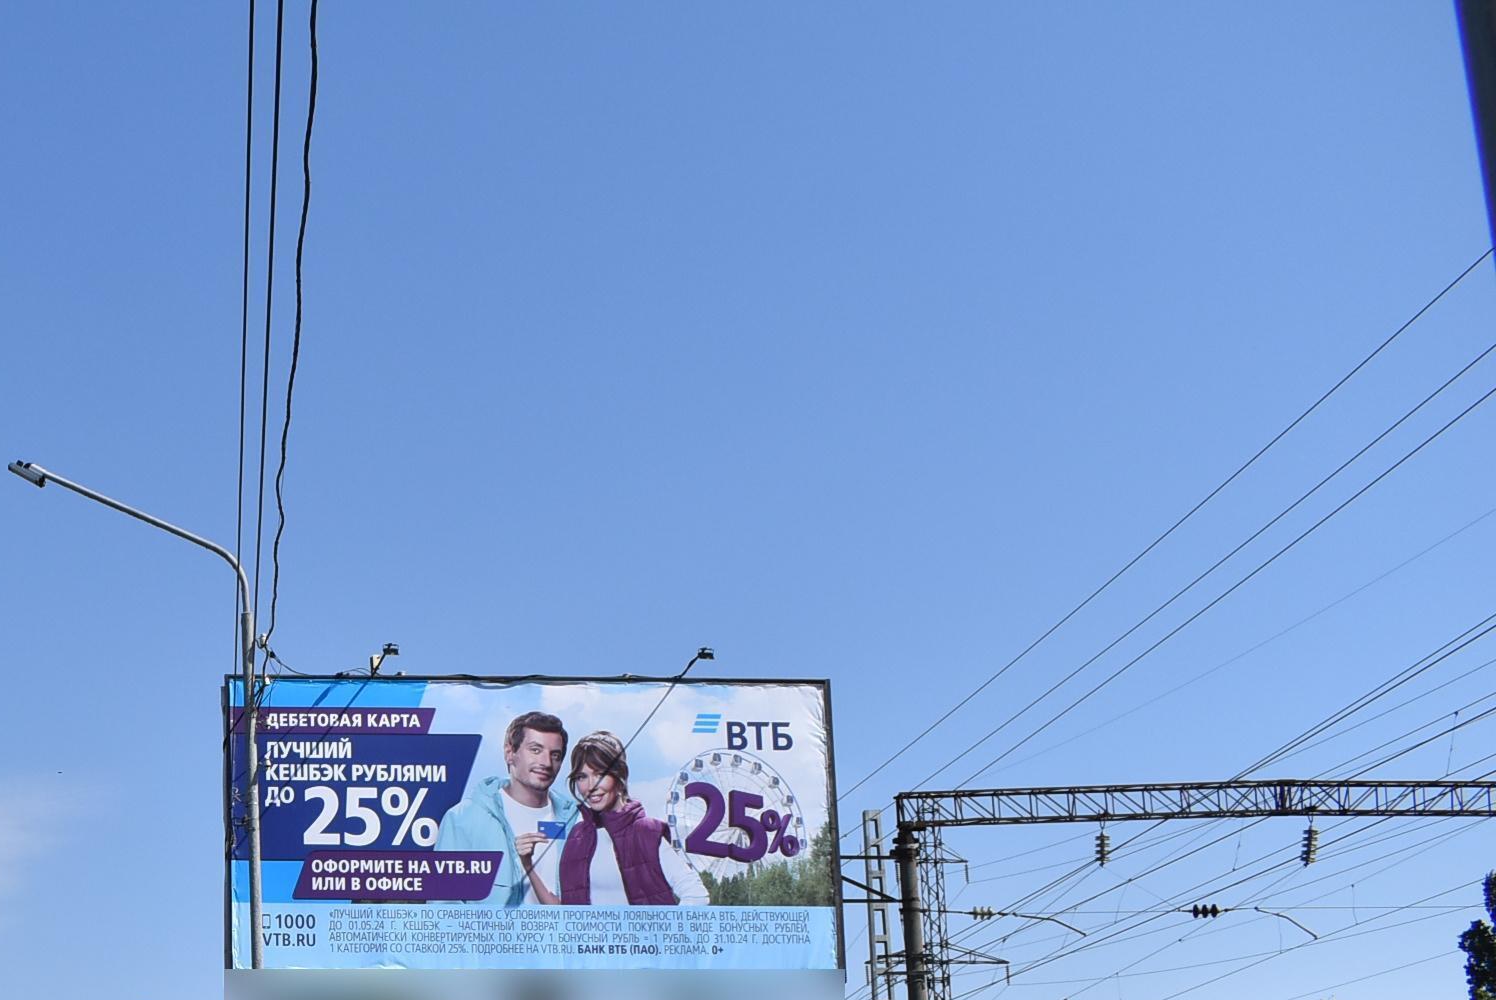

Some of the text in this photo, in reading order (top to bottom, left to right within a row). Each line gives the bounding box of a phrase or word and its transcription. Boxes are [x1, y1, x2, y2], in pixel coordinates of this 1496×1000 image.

[266, 712, 421, 730] ДЕБЕТОВАЯ КАРТА
[726, 721, 793, 750] ВТБ
[264, 738, 352, 759] ЛУЧШИЙ
[265, 763, 447, 783] КЕШБЭК РУБЛЯМИ
[265, 785, 440, 847] ДО 25%
[684, 781, 800, 863] 25%
[311, 859, 492, 875] ОФОРМИТЕ НА VTB.RU
[311, 876, 423, 892] ИЛИ В ОФИСЕ
[275, 914, 316, 929] 1000
[420, 910, 434, 920] ПО
[436, 910, 494, 920] СРАВНЕНИЮ
[504, 910, 560, 920] УСЛОВИЯМИ
[562, 910, 620, 920] ПРОГРАММЫ
[622, 911, 683, 921] ЛОЯЛЬНОСТИ
[686, 911, 716, 921] БАНКА
[740, 910, 810, 923] ДЕЙСТВУЮЩЕЙ
[328, 921, 342, 931] ДО
[404, 921, 440, 931] КЕШБЭК
[458, 920, 515, 931] ЧАСТИЧНЫЙ
[520, 922, 559, 931] ВОЗВРАТ
[564, 922, 622, 931] СТОИМОСТИ
[628, 922, 672, 932] ПОКУПКИ
[690, 923, 714, 933] ВИДЕ
[719, 923, 768, 932] БОНУСНЫХ
[262, 933, 316, 947] VTB.RU
[328, 932, 407, 942] АВТОМАТИЧЕСКИ
[411, 933, 494, 942] КОНВЕРТИРУЕМЫХ
[498, 933, 512, 942] ПО
[516, 933, 544, 943] КУРСУ
[558, 932, 608, 943] БОНУСНЫЙ
[612, 934, 640, 943] РУБЛЬ
[696, 934, 710, 945] ДО
[762, 935, 811, 945] ДОСТУПНА
[336, 943, 388, 953] КАТЕГОРИЯ
[389, 943, 402, 953] СО
[404, 942, 446, 954] СТАВКОЙ
[471, 944, 526, 955] ПОДРОБНЕЕ
[526, 944, 540, 954] НА
[577, 944, 606, 954] БАНК
[608, 945, 628, 955] ВТБ
[630, 945, 662, 955] (ПАО).
[712, 945, 724, 955] 0+
